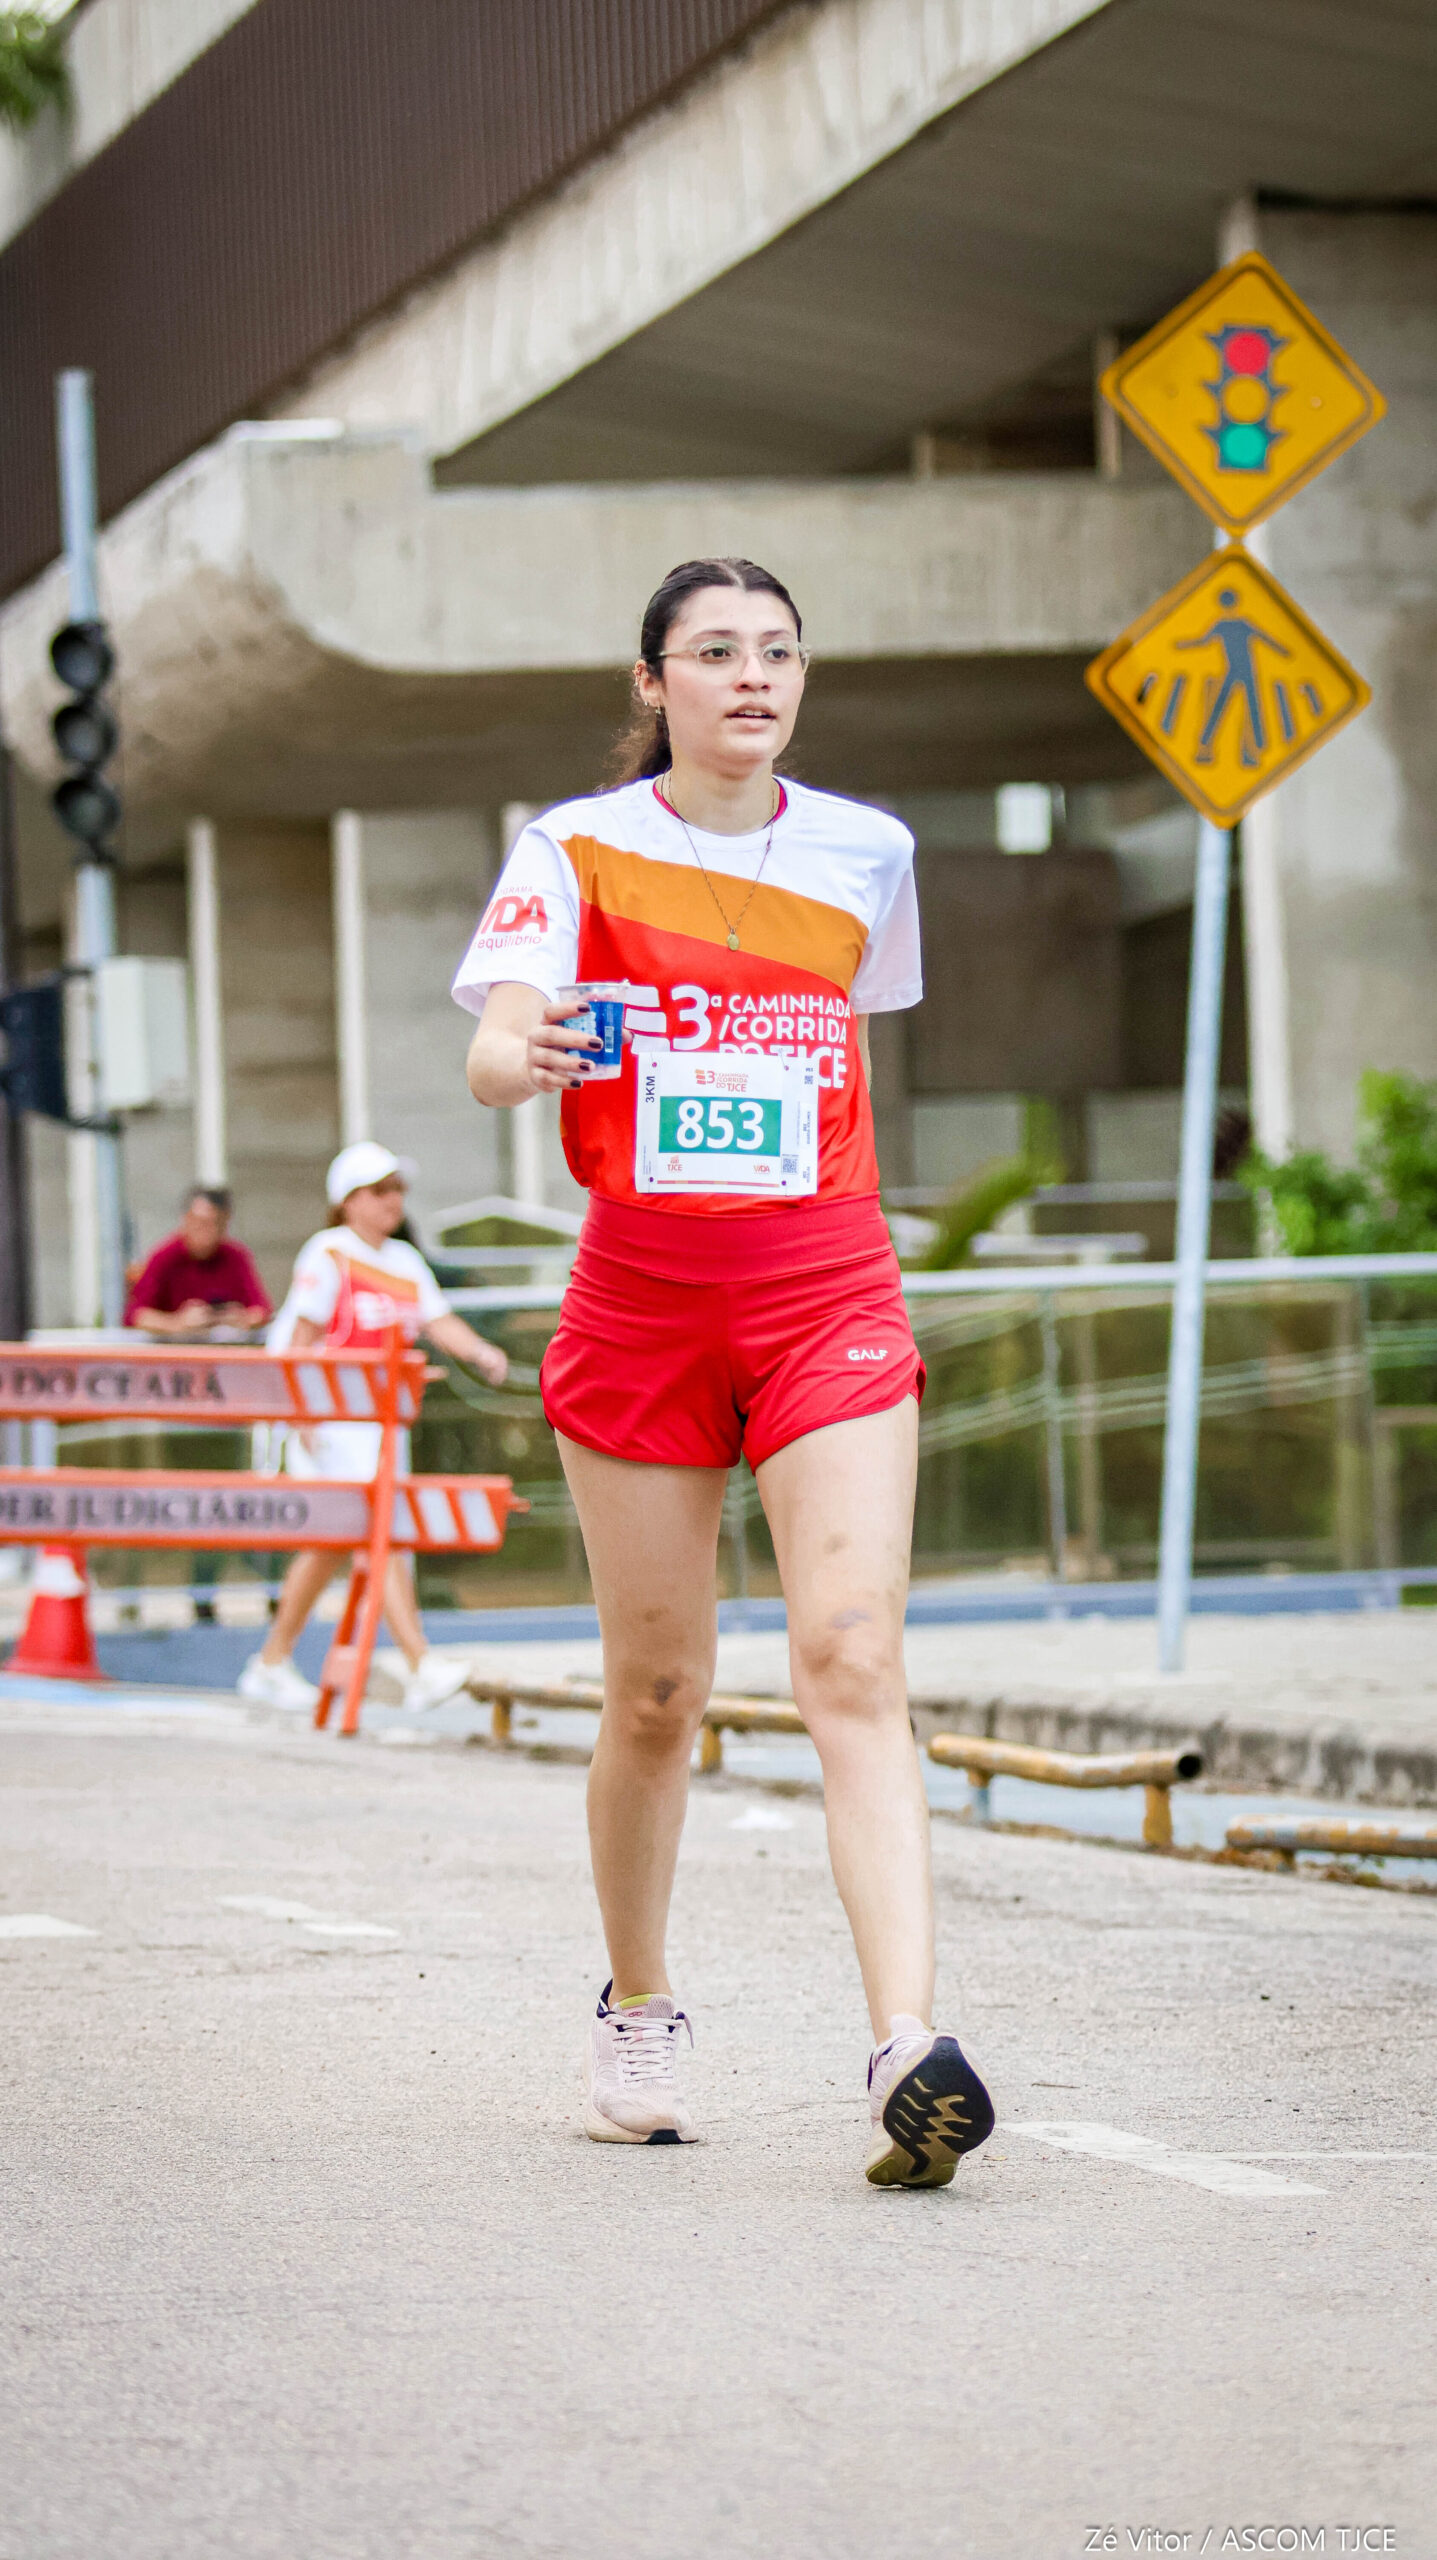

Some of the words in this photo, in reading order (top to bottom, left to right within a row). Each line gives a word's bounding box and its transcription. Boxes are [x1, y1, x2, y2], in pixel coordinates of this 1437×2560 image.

[728, 994, 851, 1020] CAMINHADA
[718, 1014, 848, 1045] /CORRIDA
[645, 1075, 656, 1104] 3KM
[726, 1083, 747, 1093] TJCE
[676, 1099, 765, 1151] 853
[667, 1163, 683, 1172] TJCE
[847, 1348, 888, 1360] GALF
